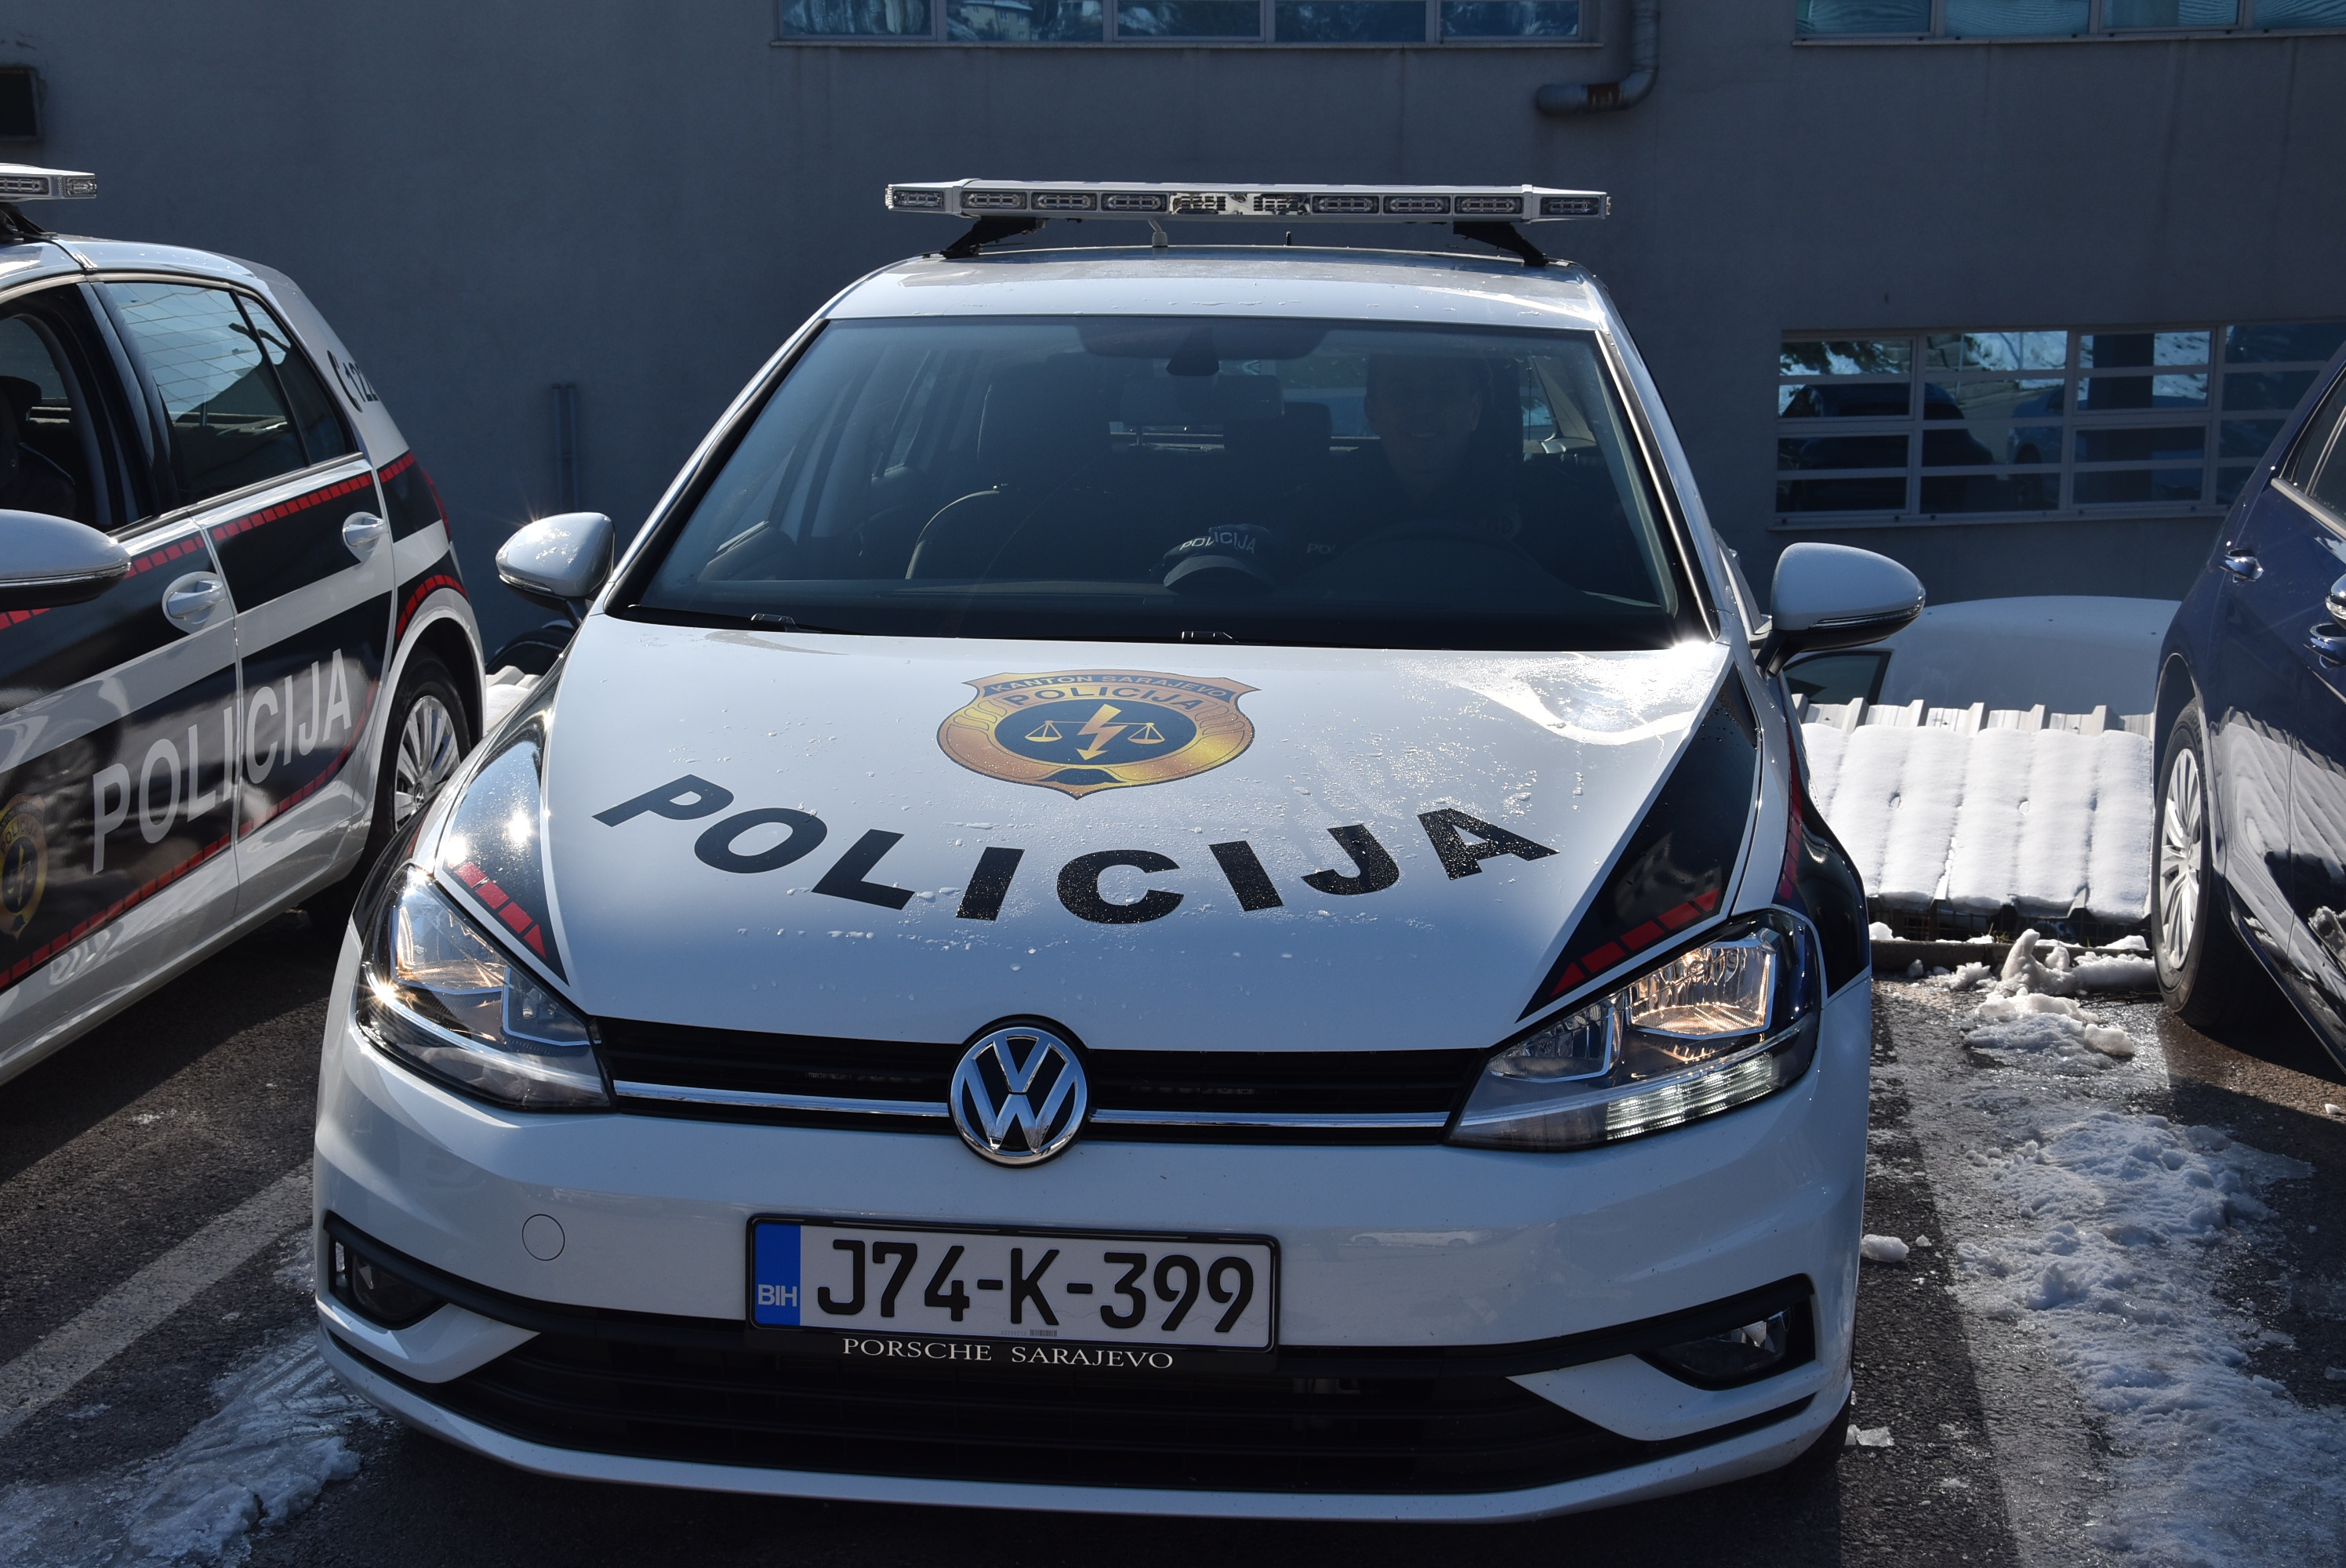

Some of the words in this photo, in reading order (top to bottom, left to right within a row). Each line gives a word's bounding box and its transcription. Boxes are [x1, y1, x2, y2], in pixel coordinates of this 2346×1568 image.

[1178, 531, 1256, 554] POLICIJA
[991, 675, 1093, 692] KANTON
[1101, 675, 1227, 697] SARAJEVO
[1004, 686, 1204, 710] POLICIJA
[93, 648, 352, 875] POLICIJA
[592, 773, 1560, 925] POLICIJA
[757, 1283, 797, 1308] BIH
[817, 1238, 1255, 1334] J74-K-399
[842, 1338, 993, 1362] PORSCHE
[1011, 1345, 1174, 1370] SARAJEVO
